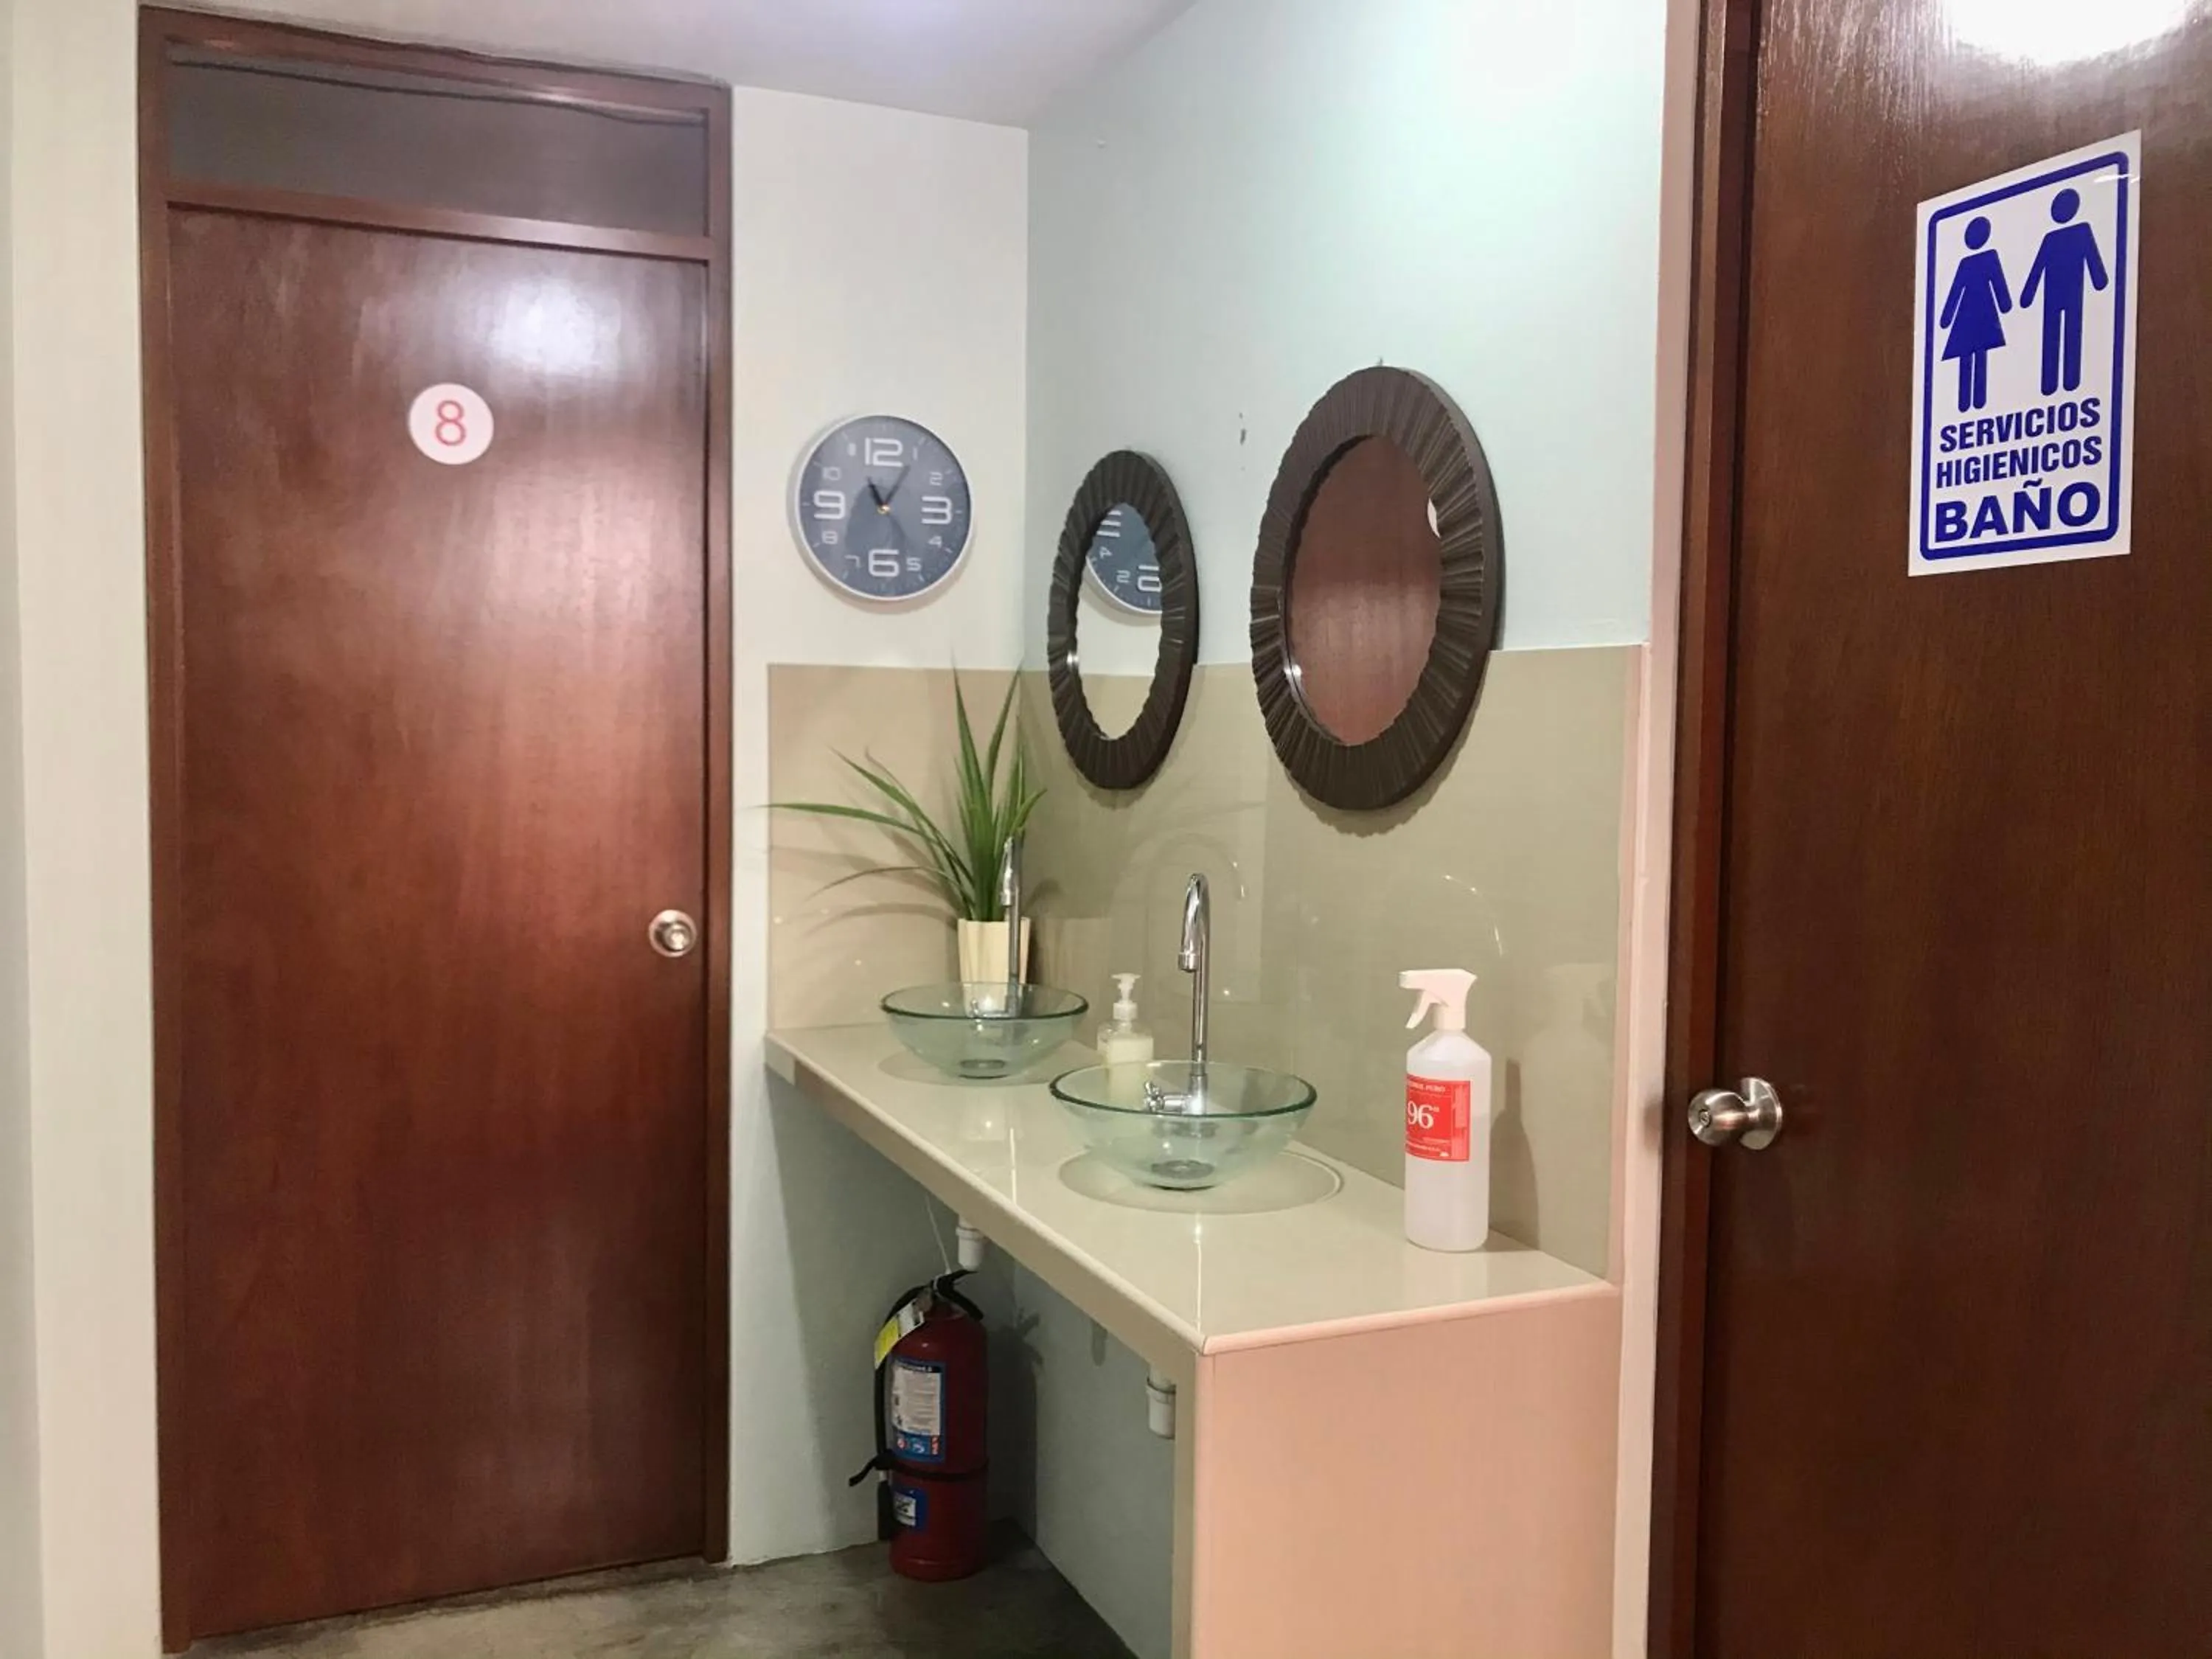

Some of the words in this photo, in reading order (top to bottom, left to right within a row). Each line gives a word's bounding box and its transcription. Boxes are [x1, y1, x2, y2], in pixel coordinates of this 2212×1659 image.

[436, 400, 465, 446] 8
[1939, 396, 2101, 453] SERVICIOS
[864, 437, 903, 467] 12
[912, 446, 918, 461] 1
[1935, 435, 2103, 489] HIGIENICOS
[930, 472, 942, 485] 2
[813, 490, 846, 520] 9
[921, 495, 953, 524] 3
[1934, 476, 2101, 543] BAÑO
[821, 531, 838, 544] 8
[928, 535, 942, 548] 4
[845, 554, 861, 568] 7
[868, 549, 900, 577] 6
[906, 557, 921, 571] 5
